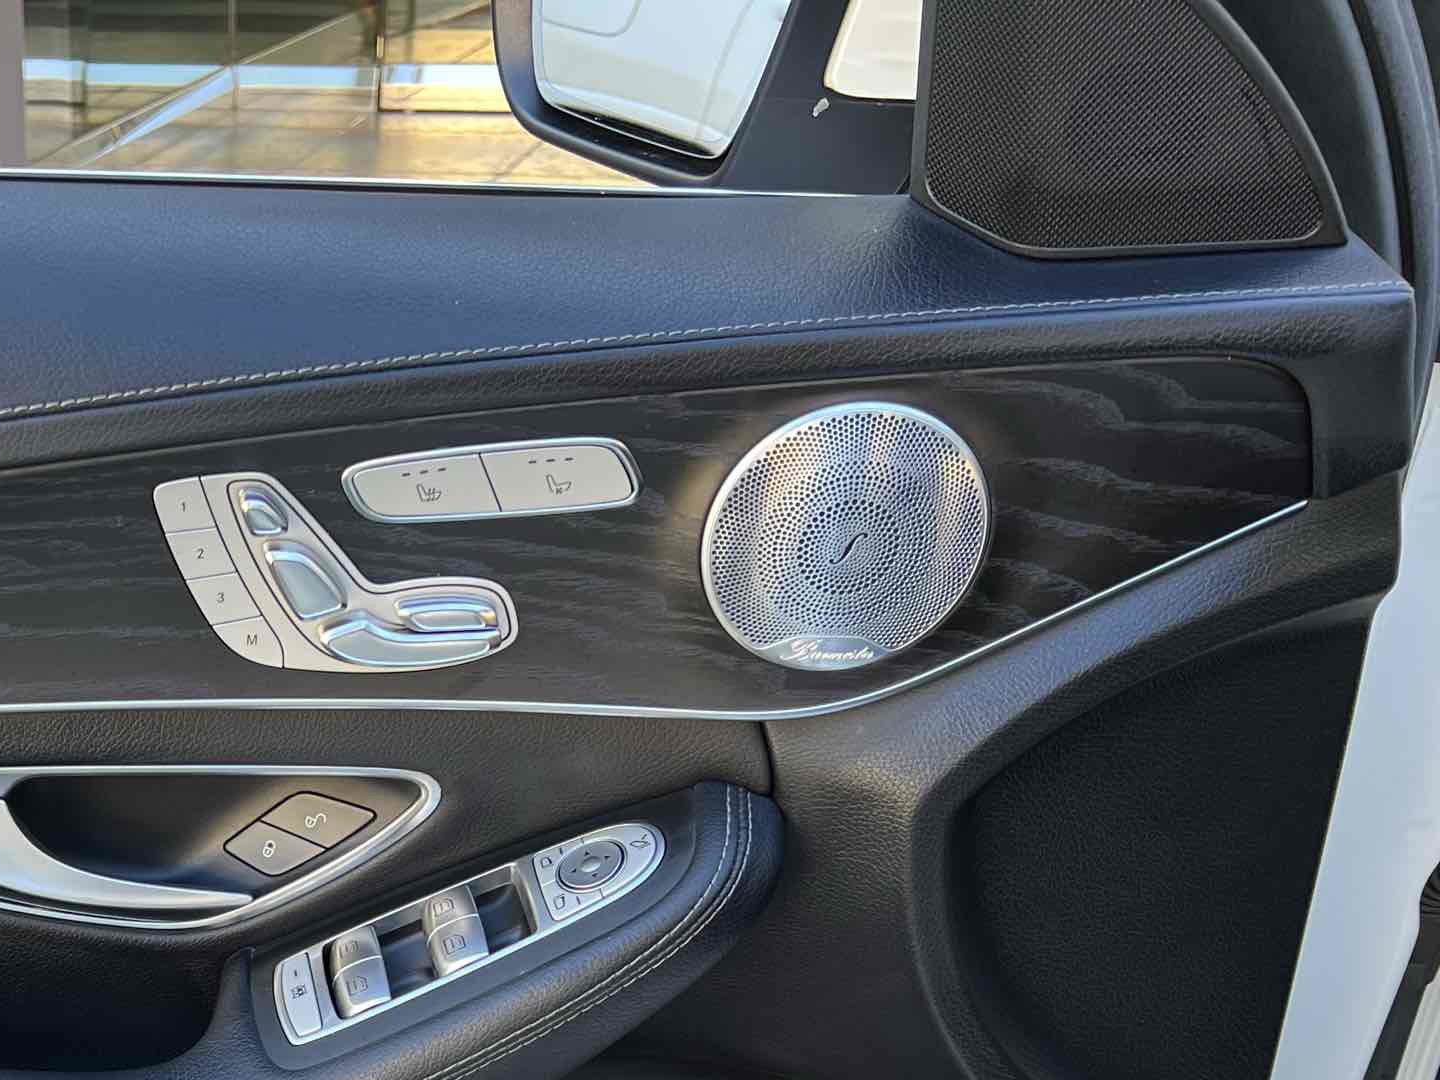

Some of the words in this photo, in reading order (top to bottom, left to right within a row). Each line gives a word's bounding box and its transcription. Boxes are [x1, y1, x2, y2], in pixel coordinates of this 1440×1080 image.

[180, 501, 187, 512] 1
[196, 548, 205, 560] 2
[216, 592, 225, 604] 3
[246, 634, 258, 646] M
